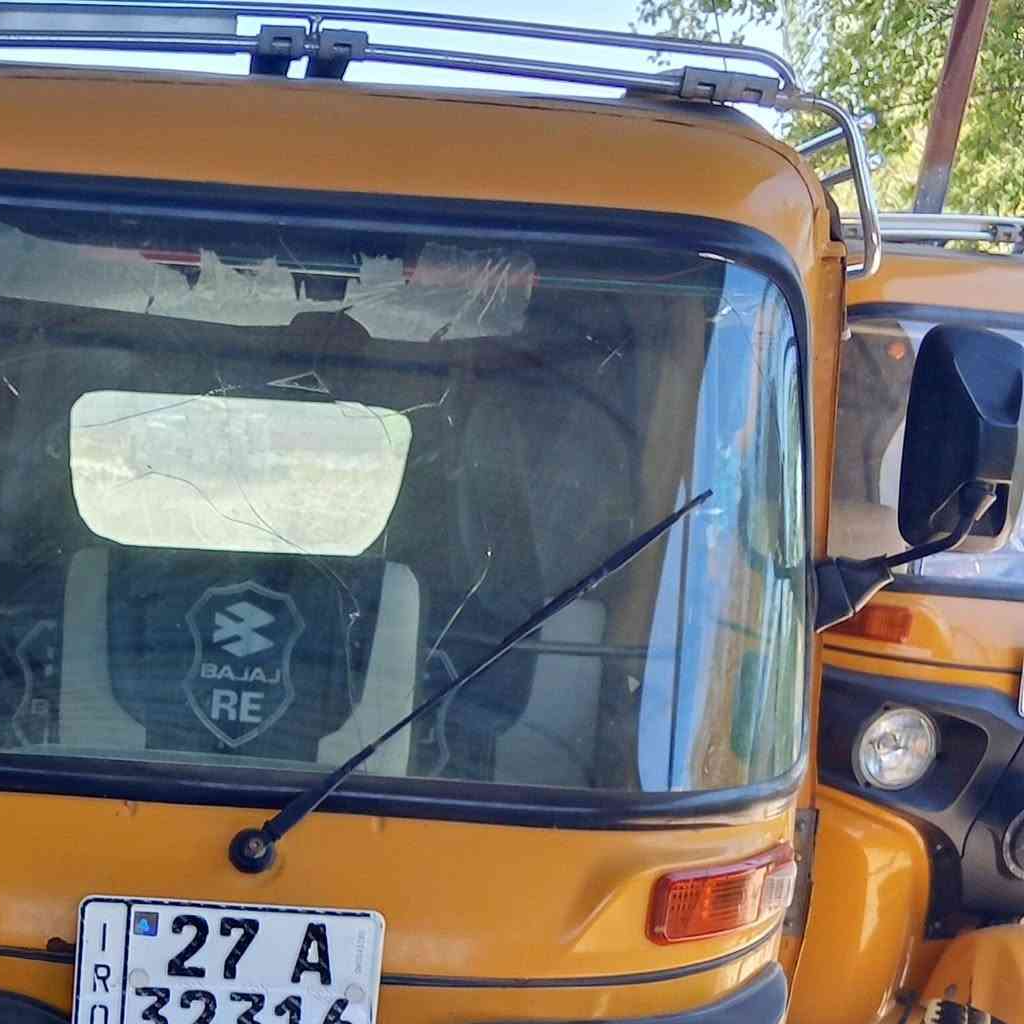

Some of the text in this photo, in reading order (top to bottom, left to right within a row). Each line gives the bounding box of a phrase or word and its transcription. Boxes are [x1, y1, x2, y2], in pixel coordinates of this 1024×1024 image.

[200, 662, 281, 684] BAJAJ
[211, 687, 265, 723] RE
[167, 914, 260, 979] 27
[291, 922, 332, 985] A
